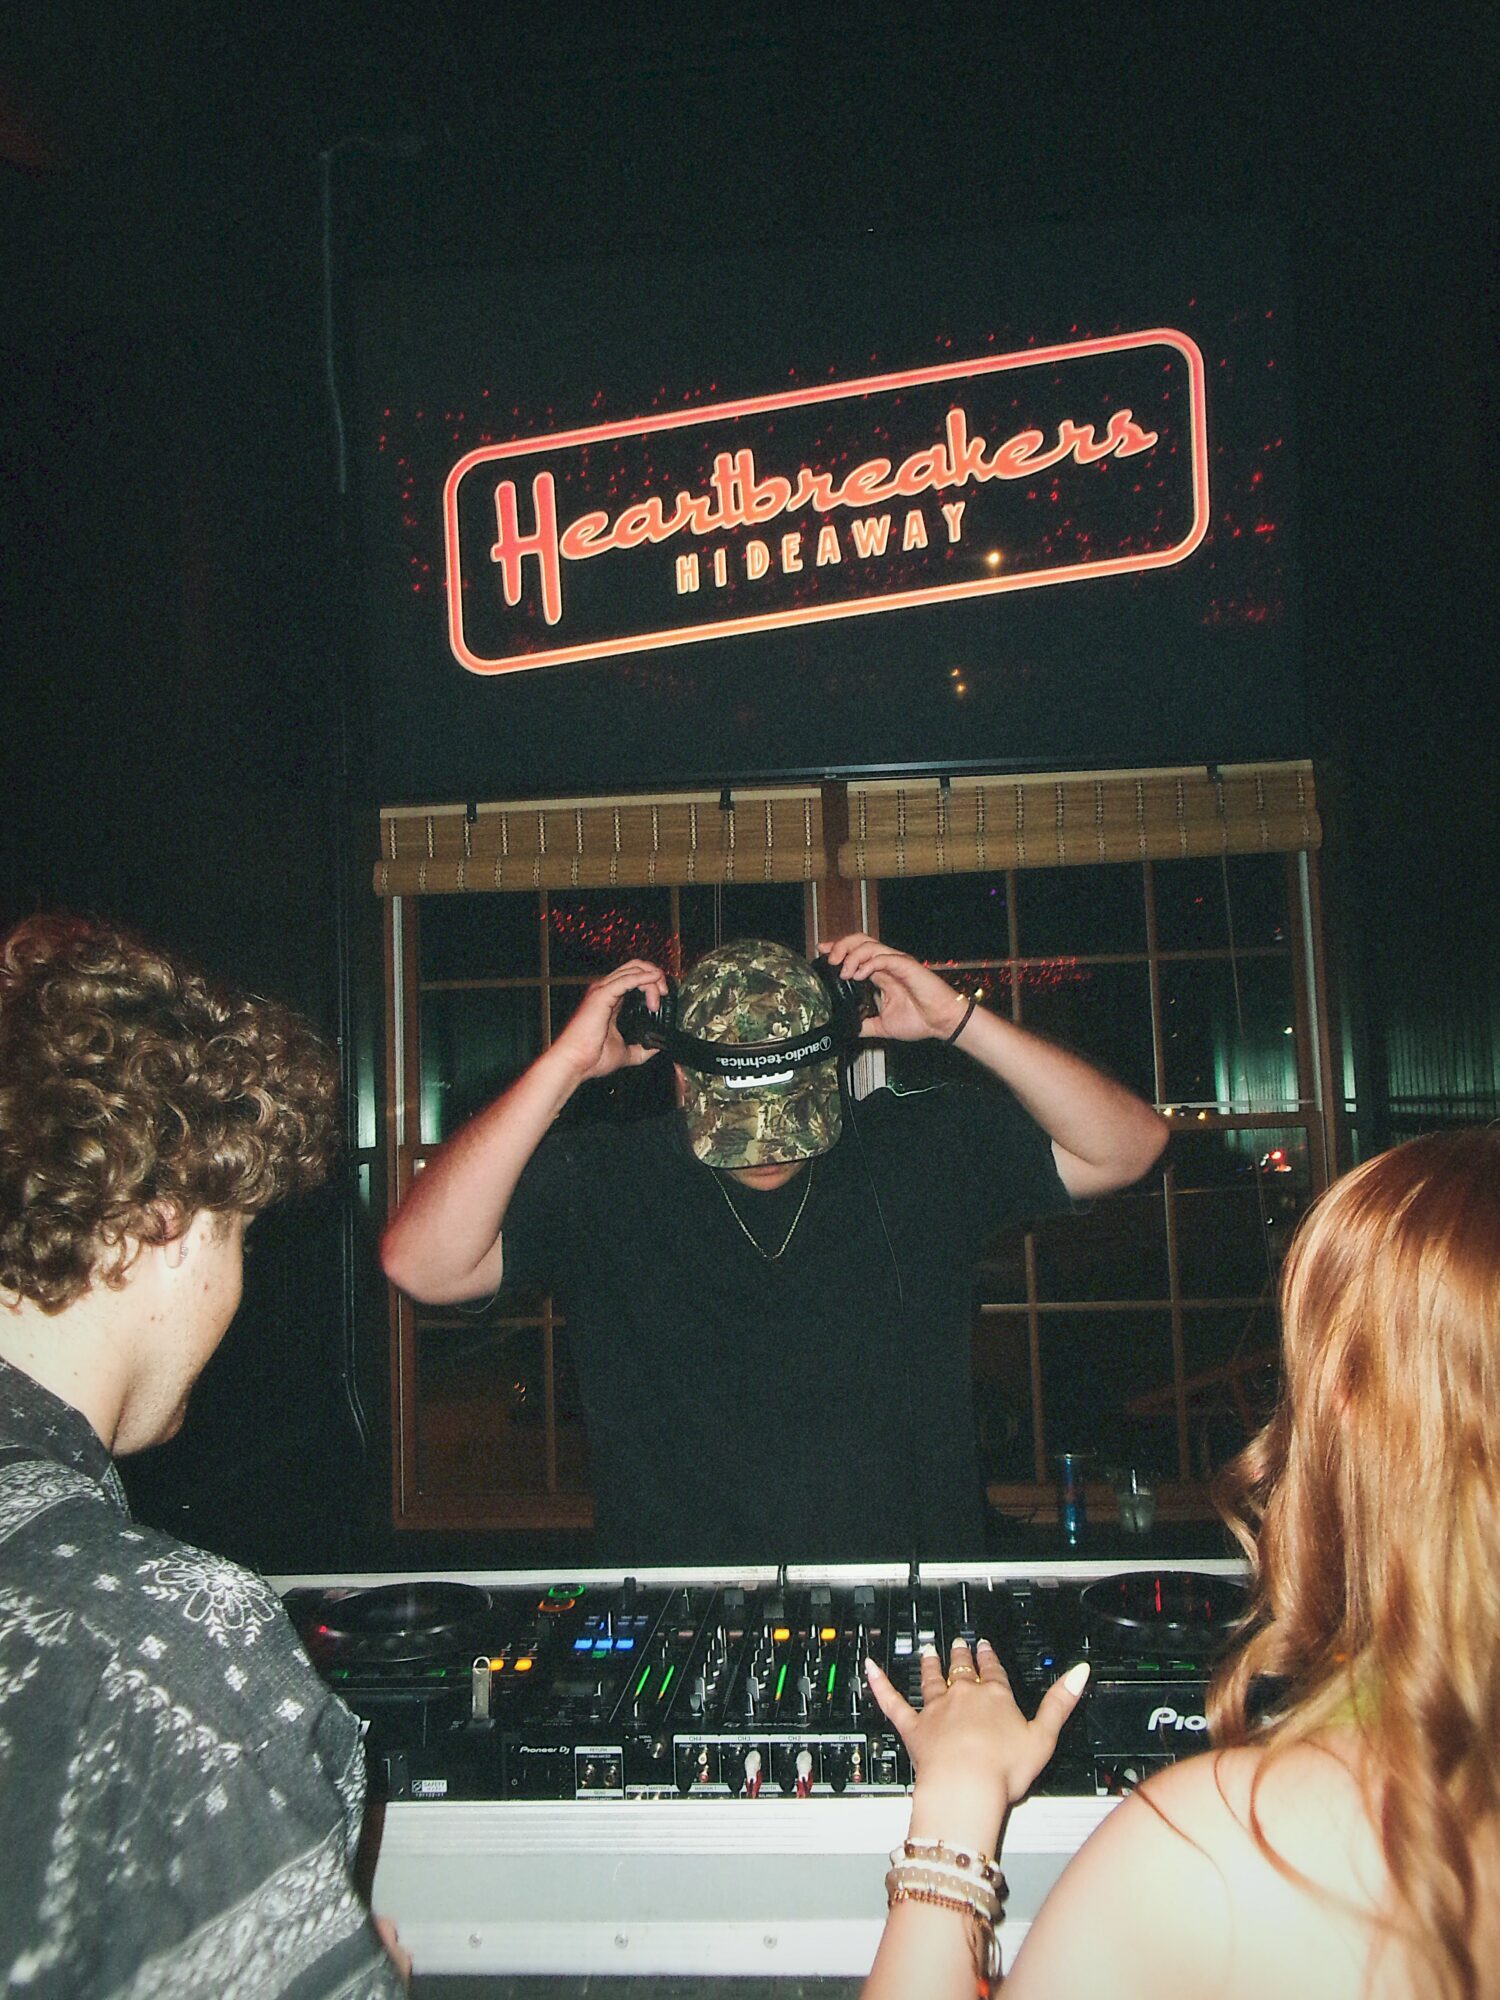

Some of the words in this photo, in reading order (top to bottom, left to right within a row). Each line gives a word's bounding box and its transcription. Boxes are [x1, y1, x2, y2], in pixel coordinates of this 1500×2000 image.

[490, 407, 1157, 625] Heartbreakers
[675, 501, 967, 595] HIDEAWAY
[720, 1042, 820, 1069] audio-technica
[1147, 1707, 1209, 1731] Pio
[519, 1746, 558, 1754] Pioneer
